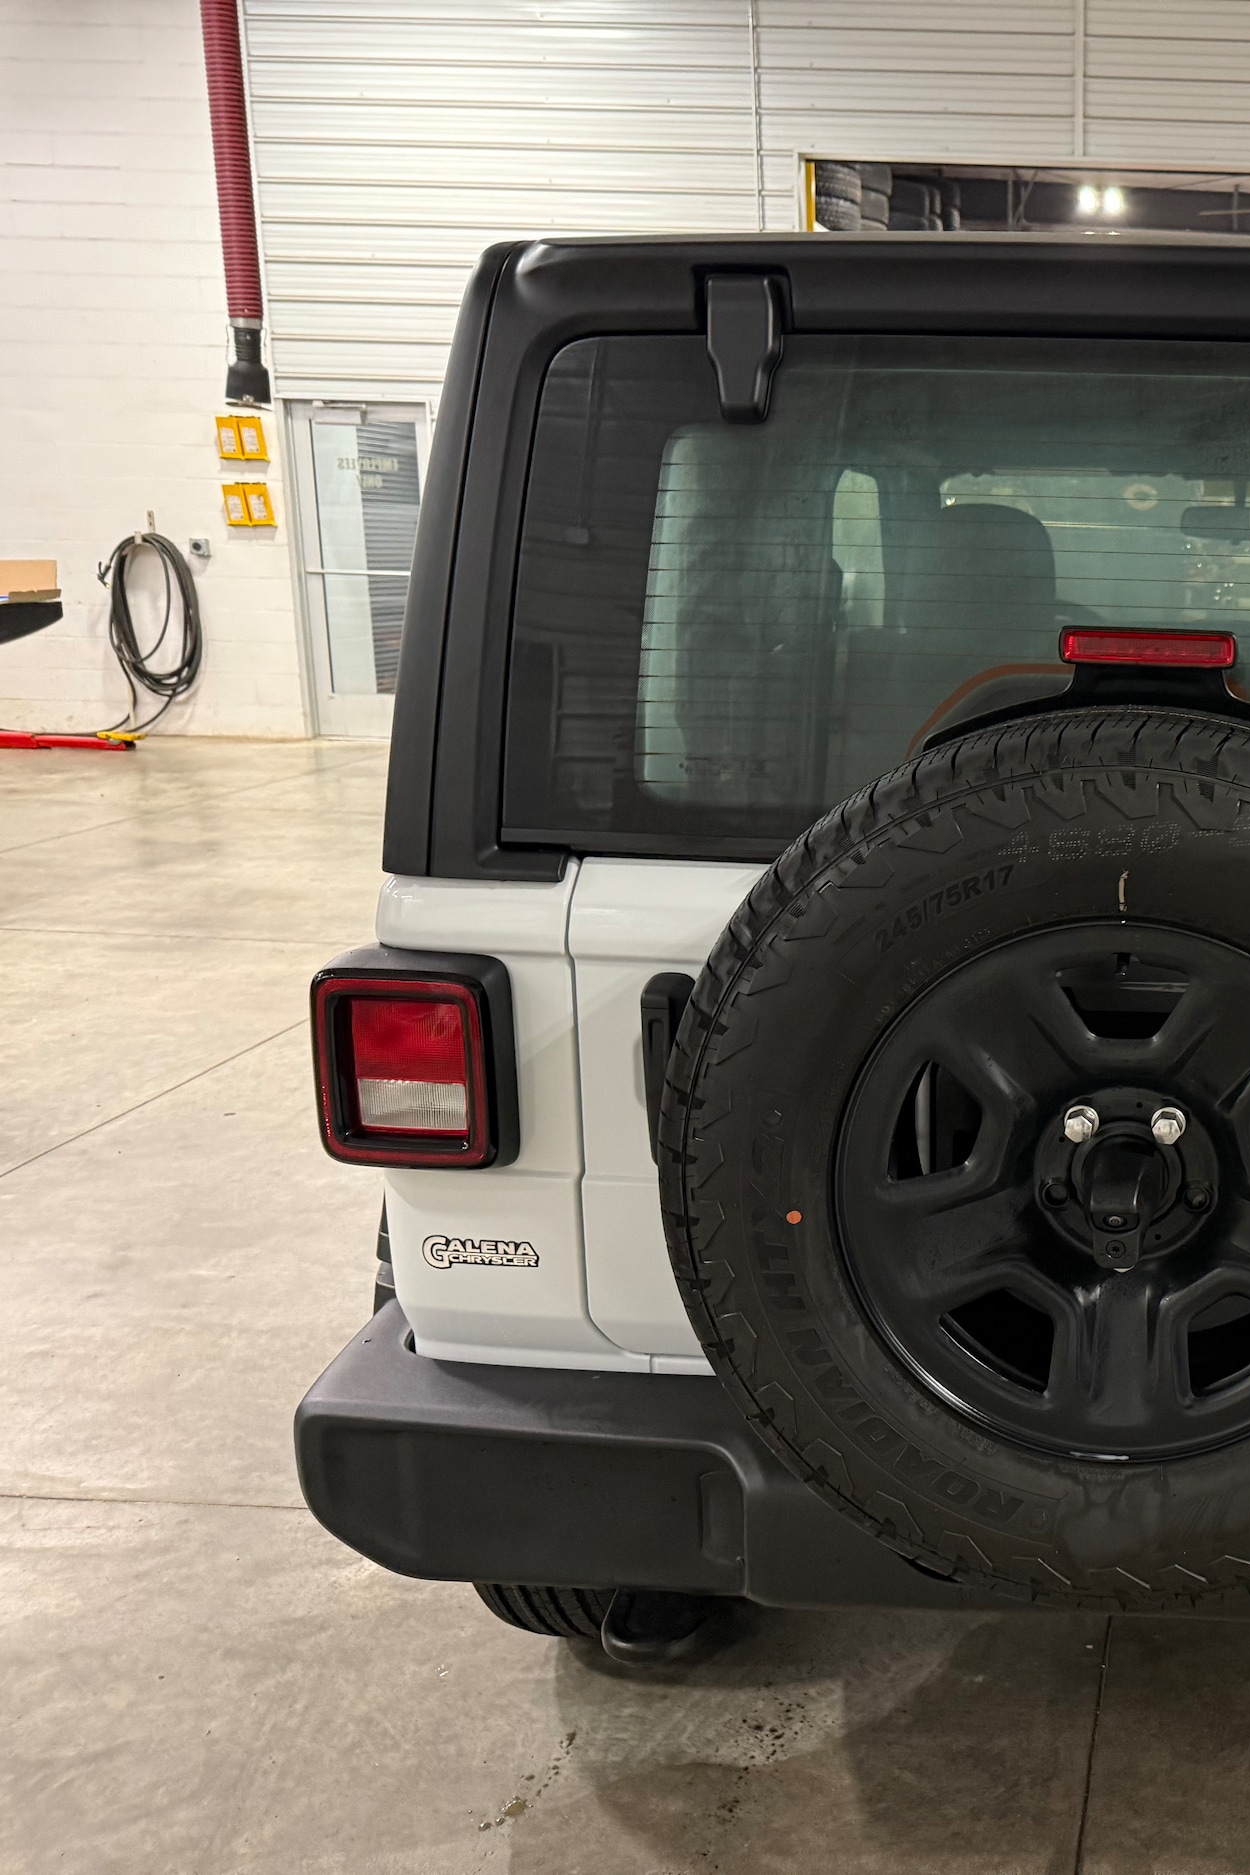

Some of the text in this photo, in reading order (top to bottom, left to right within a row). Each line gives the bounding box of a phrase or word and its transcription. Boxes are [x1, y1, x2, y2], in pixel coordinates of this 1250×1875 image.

[873, 864, 1014, 952] 245/75R17
[422, 1235, 538, 1269] GALENA
[447, 1253, 539, 1267] CHRYSLER
[783, 1327, 1024, 1522] ROADIAN
